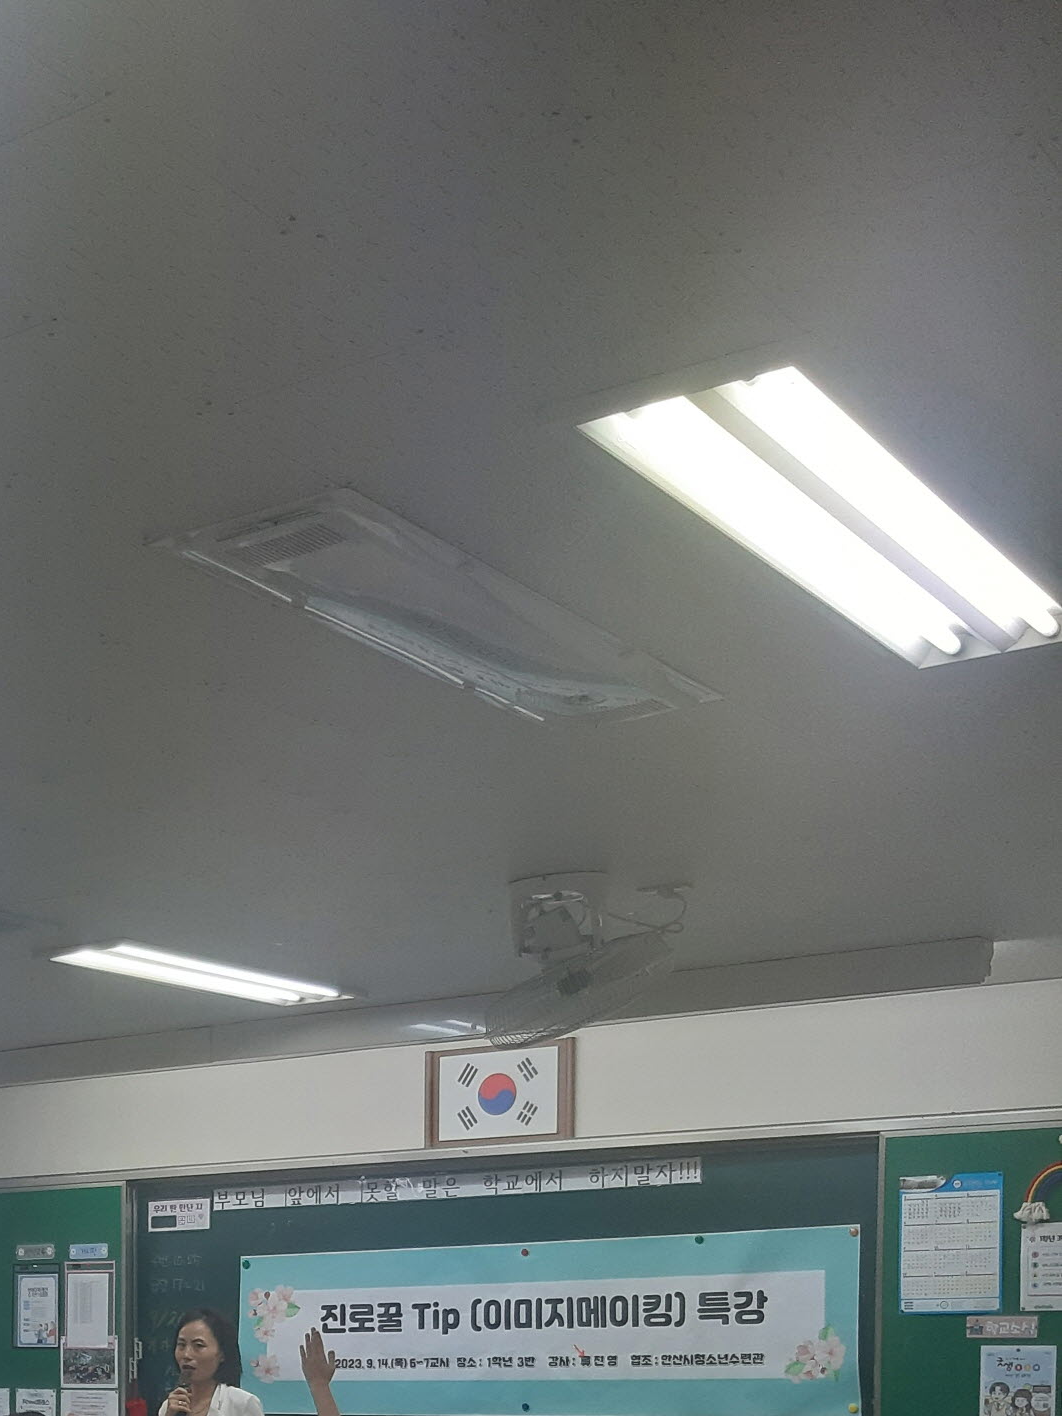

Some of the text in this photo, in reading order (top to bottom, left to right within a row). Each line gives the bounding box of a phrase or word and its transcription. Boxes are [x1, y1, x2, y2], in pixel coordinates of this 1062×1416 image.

[214, 1188, 267, 1209] 부모님
[288, 1183, 342, 1205] 앞에서
[421, 1175, 461, 1199] 말은
[482, 1169, 564, 1197] 학교에서
[588, 1160, 700, 1190] 하지말자!!!
[320, 1289, 769, 1336] 진로꿀 Tip (이미지메이킹) 특강
[487, 1355, 514, 1369] 1학년
[517, 1354, 536, 1368] 3반
[661, 1351, 765, 1366] 안산시청소년수련관
